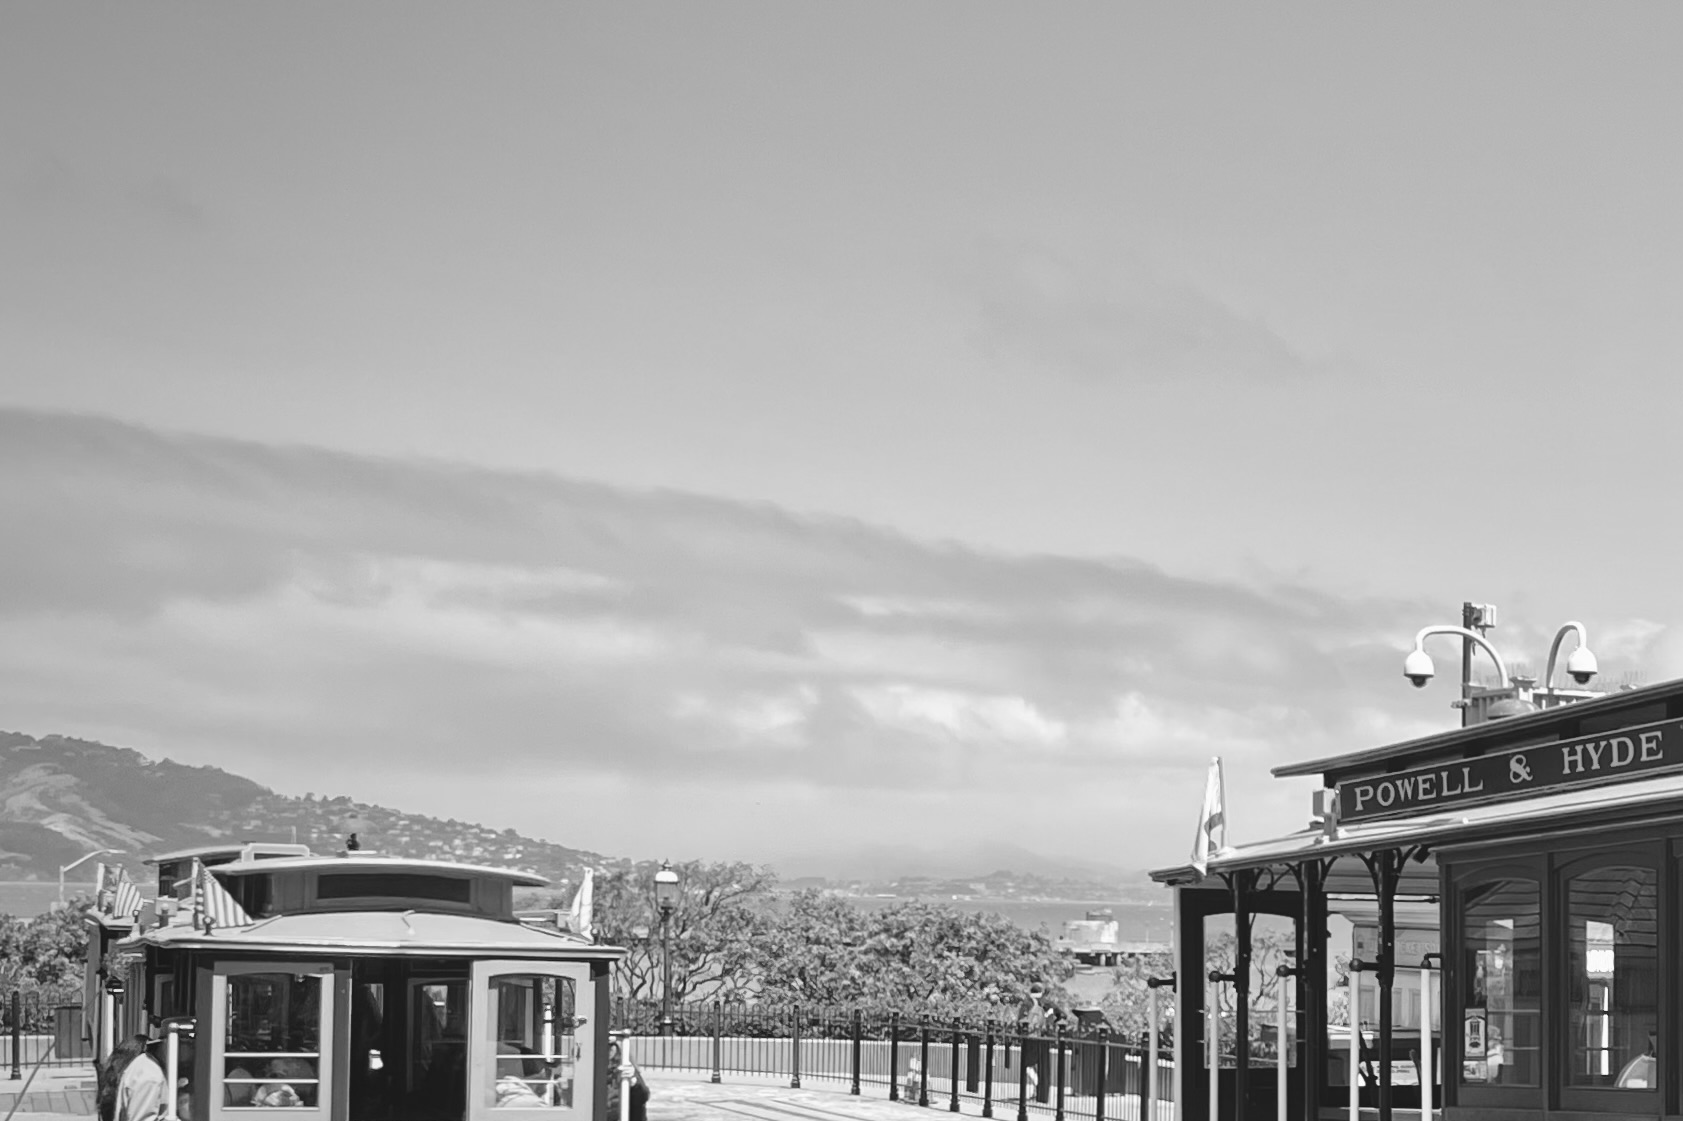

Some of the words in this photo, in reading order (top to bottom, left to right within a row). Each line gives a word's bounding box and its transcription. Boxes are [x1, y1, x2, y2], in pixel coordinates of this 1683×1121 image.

[1354, 767, 1483, 810] POWELL
[1509, 754, 1533, 783] &
[1562, 731, 1663, 774] HYDE
